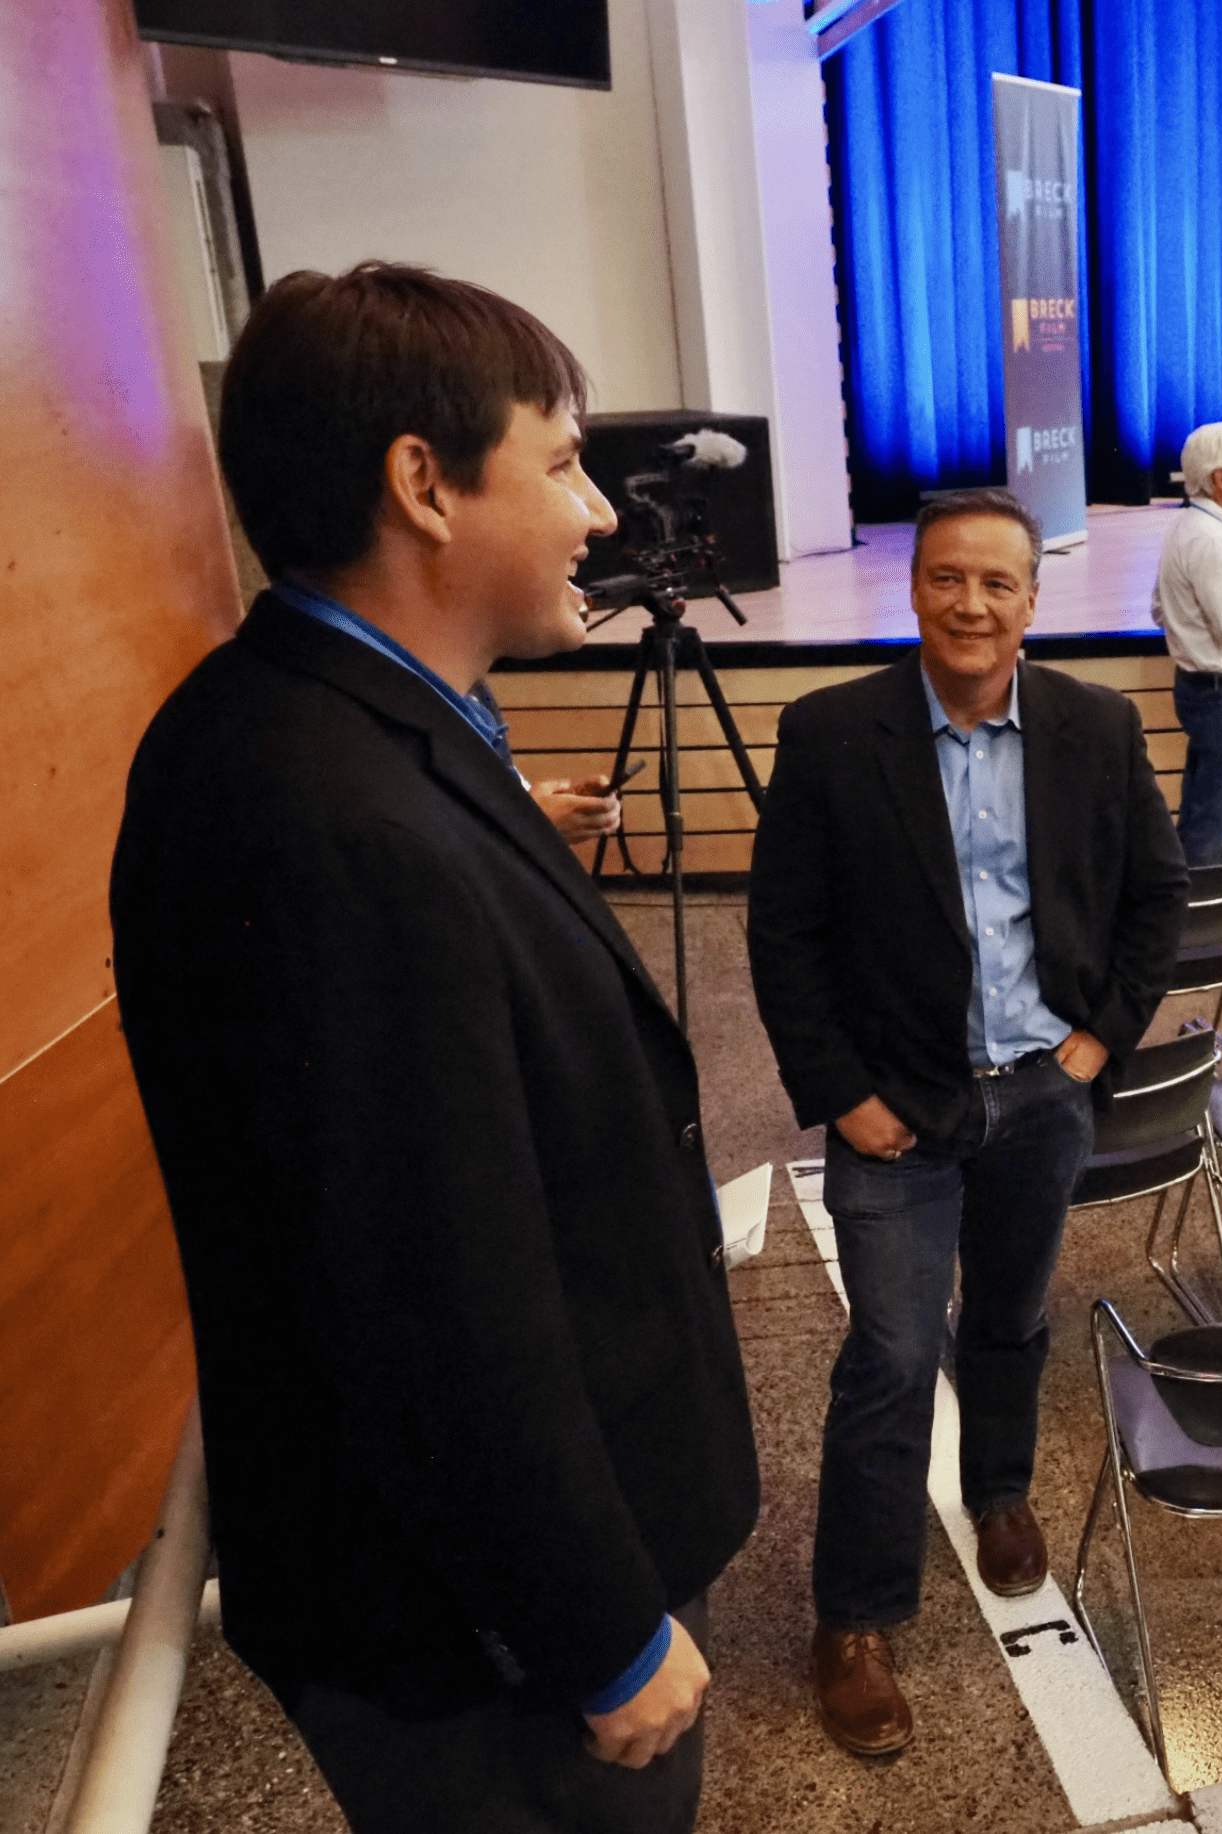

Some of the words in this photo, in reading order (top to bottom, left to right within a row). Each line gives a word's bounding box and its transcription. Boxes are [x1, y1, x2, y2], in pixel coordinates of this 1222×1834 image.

[1023, 178, 1072, 202] BRECK
[1030, 299, 1075, 318] BRECK
[1034, 427, 1076, 451] BRECK
